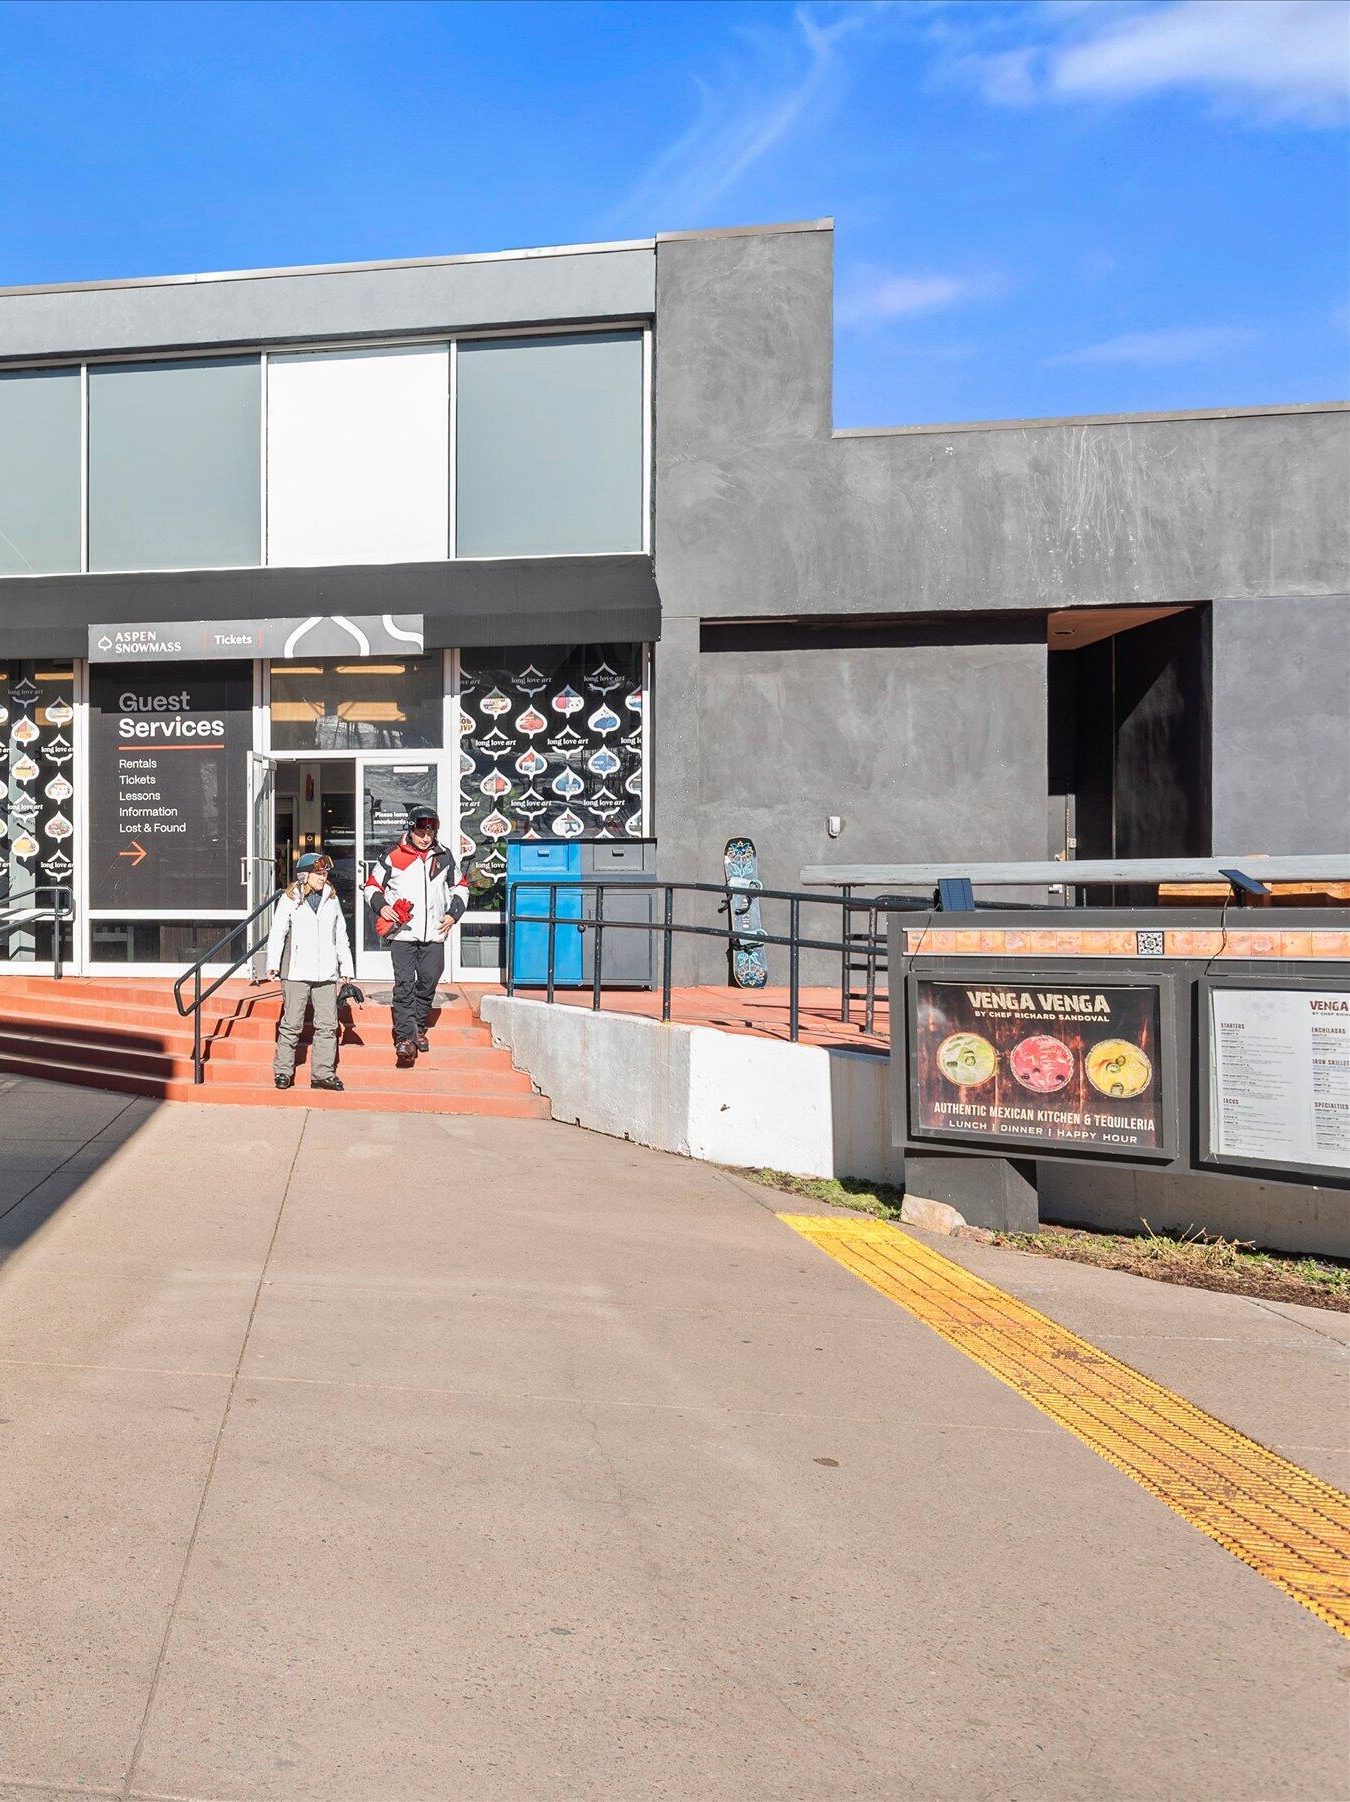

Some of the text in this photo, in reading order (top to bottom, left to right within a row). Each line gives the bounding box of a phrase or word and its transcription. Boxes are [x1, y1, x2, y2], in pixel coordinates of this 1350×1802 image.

[116, 631, 157, 642] ASPEN
[214, 634, 252, 645] Tickets
[116, 642, 182, 654] SNOWMASS
[511, 677, 526, 685] long
[583, 675, 599, 683] long
[8, 689, 21, 697] long
[119, 691, 191, 712] Guest
[119, 716, 224, 737] Services
[475, 739, 491, 748] long
[547, 738, 563, 746] long
[621, 737, 636, 746] long
[41, 746, 55, 754] long
[119, 758, 158, 769] Rentals
[119, 774, 156, 785] Tickets
[119, 791, 161, 801] Lessons
[7, 803, 21, 811] long
[511, 800, 526, 808] long
[583, 800, 599, 808] long
[119, 807, 178, 817] Information
[119, 822, 187, 833] Lost & Found
[40, 861, 54, 869] long
[475, 862, 490, 870] long
[966, 991, 1111, 1013] VENGA VENGA
[1310, 1000, 1349, 1011] VENGA
[988, 1011, 1012, 1019] CHEF
[1014, 1012, 1056, 1020] RICHARD
[1058, 1014, 1110, 1023] SANDOVAL
[1220, 1022, 1245, 1030] STARTERS
[1314, 1101, 1349, 1110] SPECIALTIES
[934, 1101, 1155, 1132] AUTHENTIC MEXICAN KITCHEN & TEQUILERIA
[949, 1120, 1138, 1144] LUNCH DINNER HAPPY HOUR
